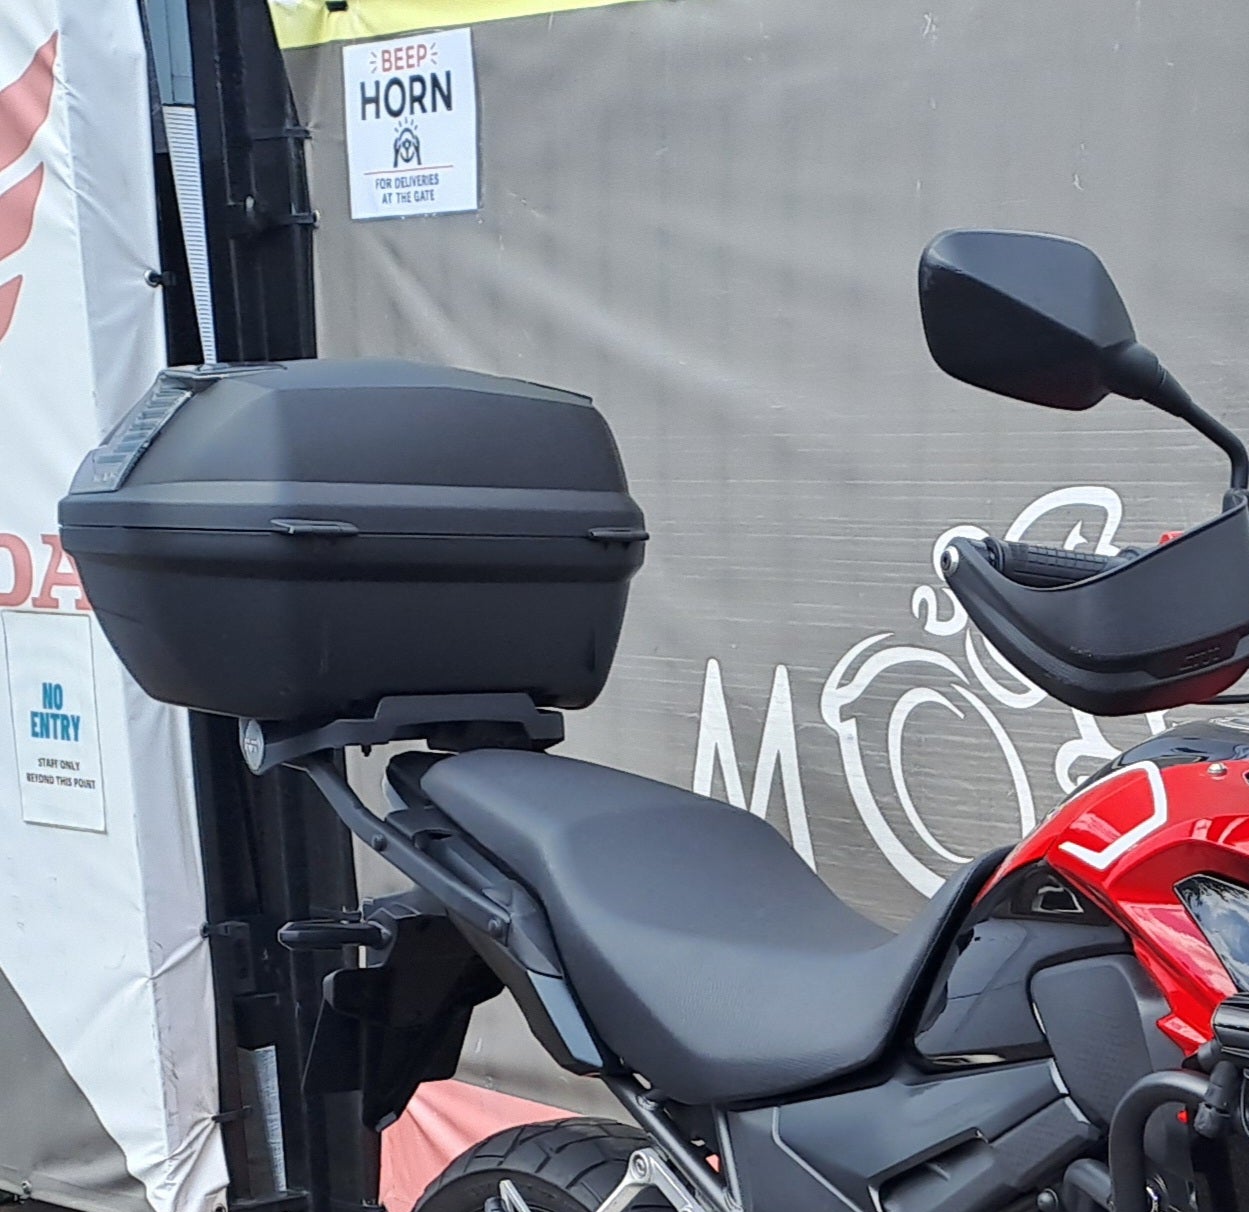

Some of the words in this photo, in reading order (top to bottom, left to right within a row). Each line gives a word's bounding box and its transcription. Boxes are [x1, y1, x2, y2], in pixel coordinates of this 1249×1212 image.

[381, 43, 427, 72] BEEP
[360, 70, 453, 120] HORN
[375, 178, 392, 189] FOR
[394, 173, 440, 189] DELIVERIES
[381, 193, 393, 204] AT
[396, 191, 412, 203] THE
[413, 189, 435, 202] GATE
[42, 682, 63, 710] NO
[30, 710, 80, 742] ENTRY
[37, 757, 58, 769] STAFF
[60, 759, 80, 771] ONLY
[26, 772, 54, 785] BEYOND
[56, 775, 72, 787] THIS
[73, 778, 96, 790] POINT
